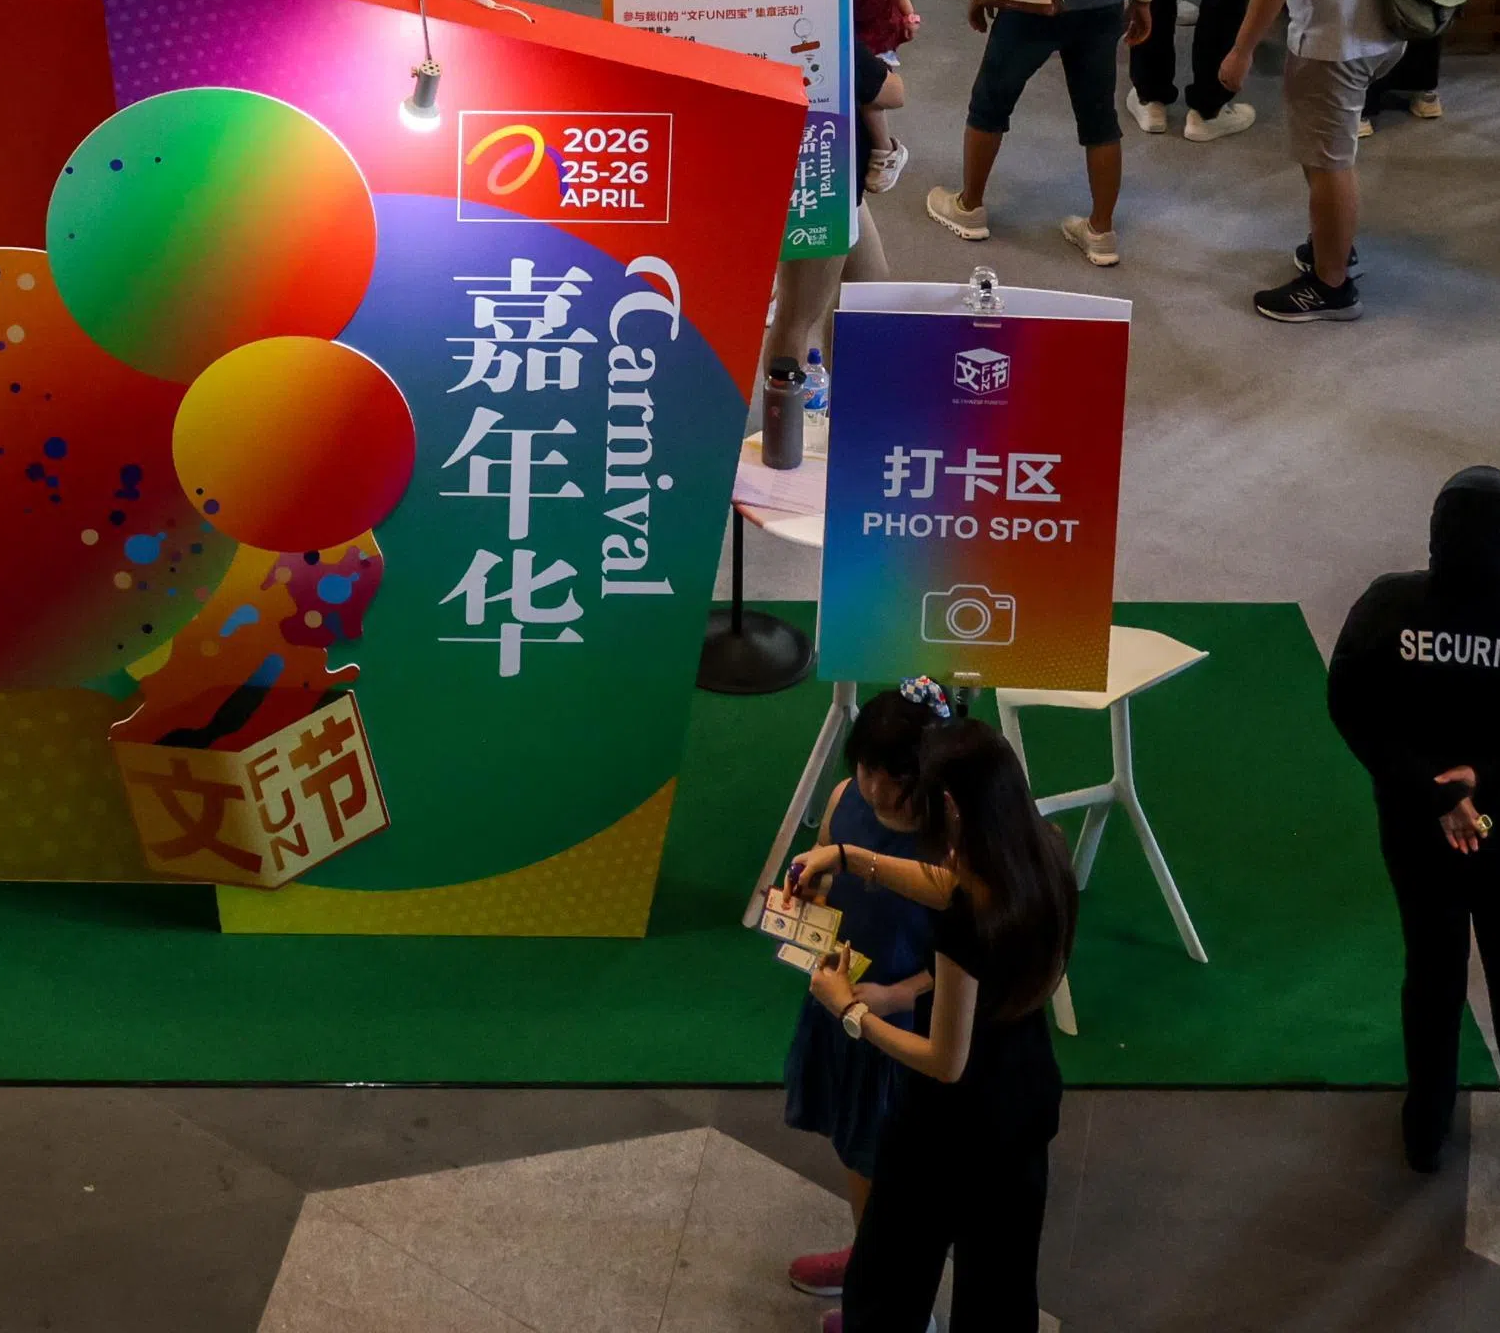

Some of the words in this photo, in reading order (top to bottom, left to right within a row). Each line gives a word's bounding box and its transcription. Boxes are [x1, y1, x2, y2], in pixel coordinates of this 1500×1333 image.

[563, 124, 650, 156] 2026
[819, 119, 837, 199] Carnival
[560, 187, 647, 209] APRIL
[561, 158, 650, 187] 25-26
[600, 254, 681, 602] Carnival
[437, 257, 599, 678] 嘉年华
[882, 445, 1063, 503] 打卡区
[862, 511, 976, 542] PHOTO
[989, 514, 1081, 545] SPOT
[132, 755, 263, 874] 文
[298, 715, 370, 842] 节
